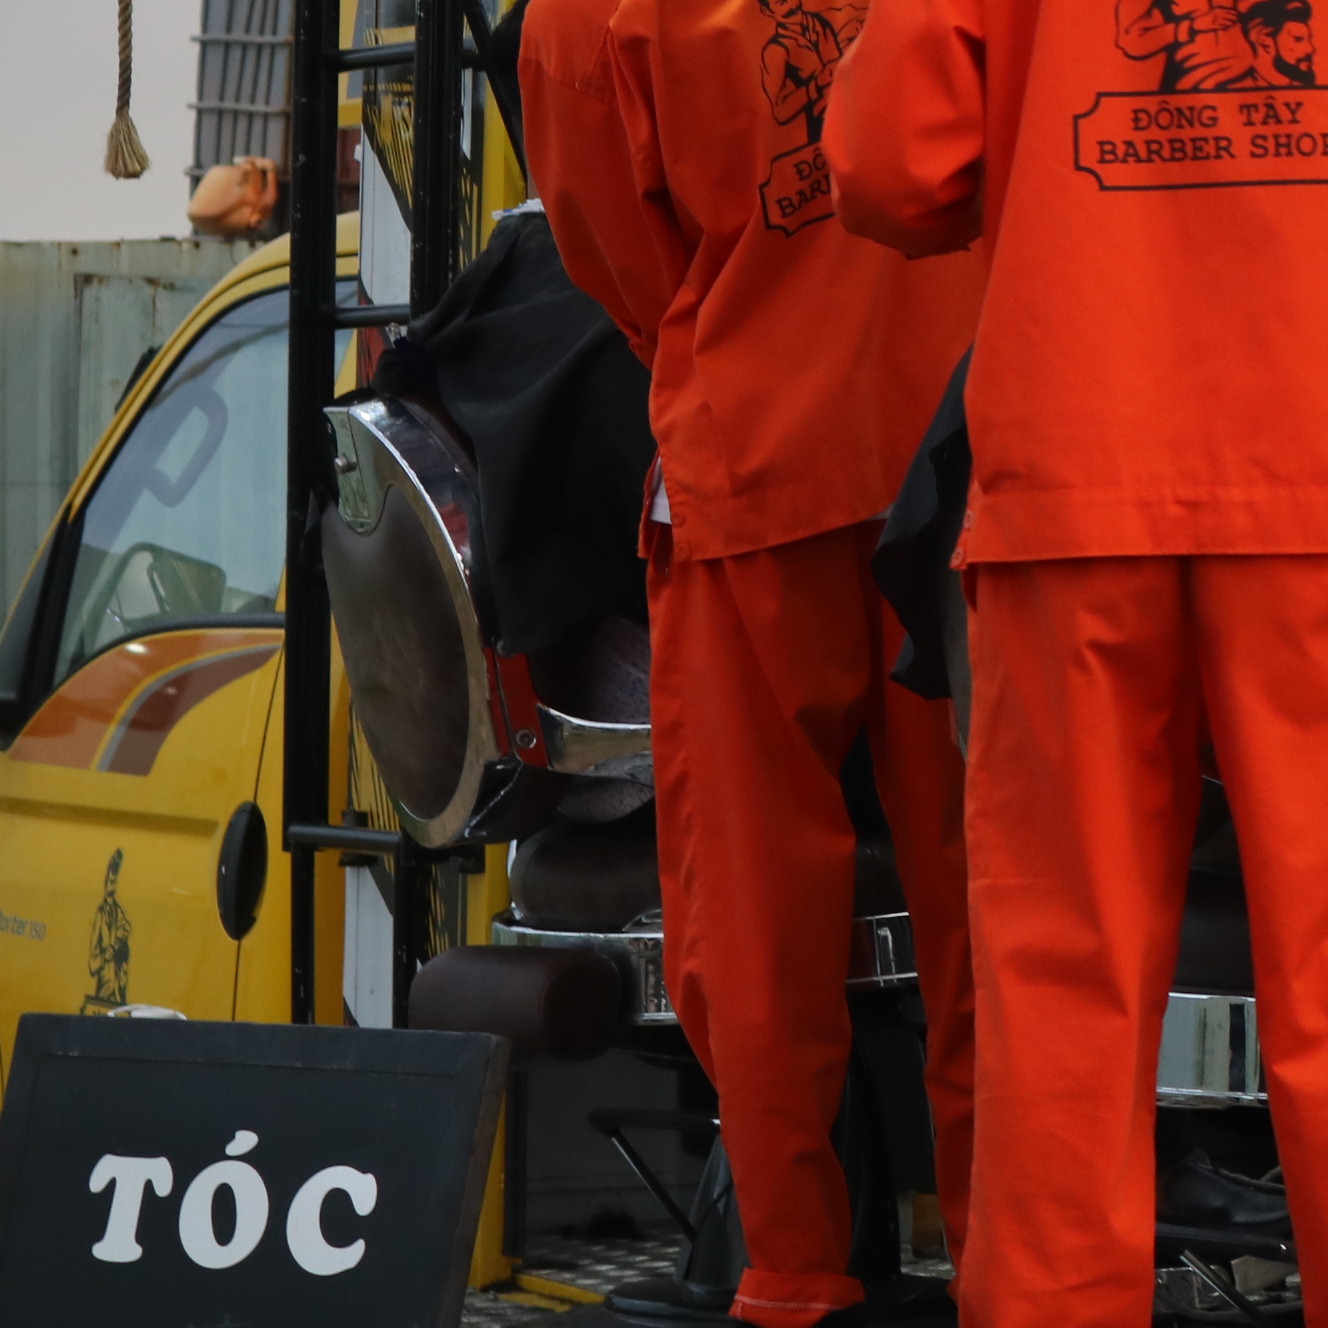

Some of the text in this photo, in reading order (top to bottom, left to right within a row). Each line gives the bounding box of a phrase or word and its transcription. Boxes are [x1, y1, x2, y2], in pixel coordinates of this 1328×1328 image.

[1131, 96, 1304, 131] ĐÔNG TÂY
[794, 147, 827, 181] ĐÔ
[1096, 136, 1236, 165] BARBER
[88, 1129, 378, 1277] TÓC
